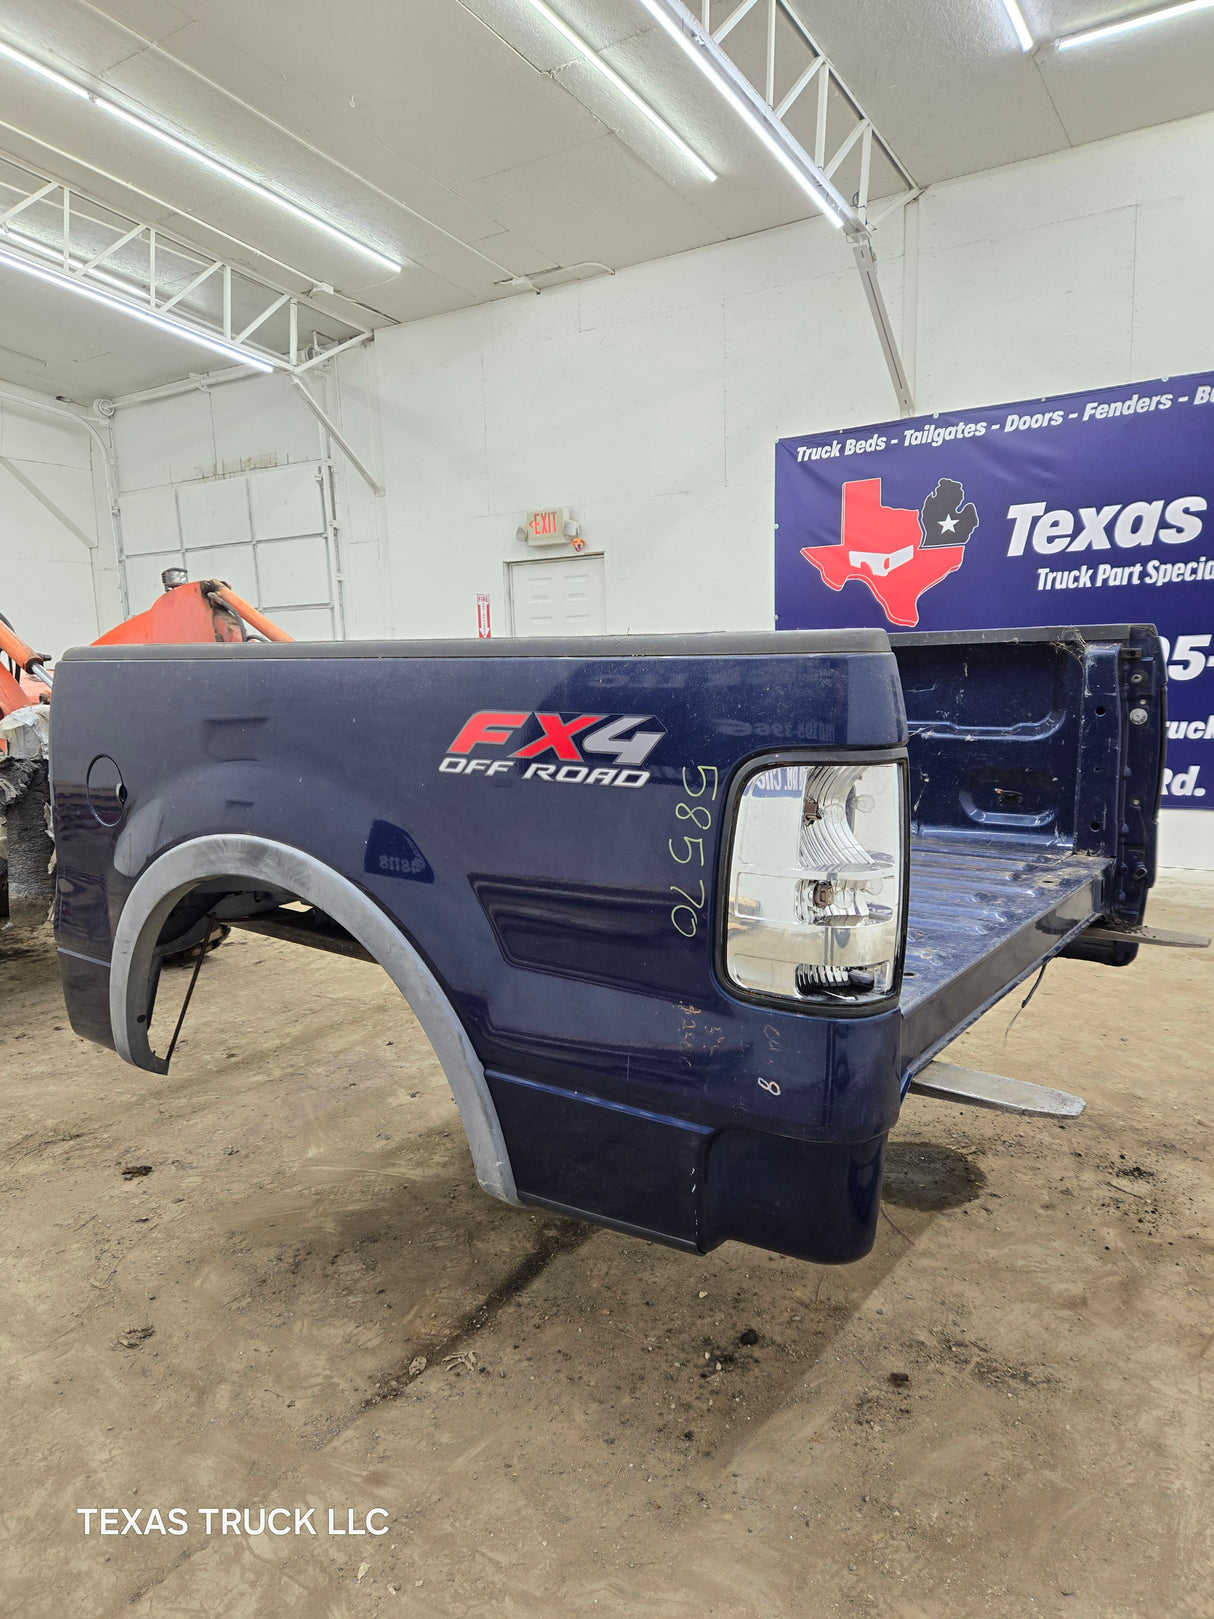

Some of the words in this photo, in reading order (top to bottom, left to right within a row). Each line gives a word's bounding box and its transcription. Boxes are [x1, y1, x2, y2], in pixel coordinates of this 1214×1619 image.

[797, 440, 842, 462] Truck
[844, 433, 887, 455] Beds
[903, 421, 987, 447] Tailgates
[1004, 410, 1064, 432] Doors
[1082, 393, 1173, 421] Fenders
[533, 511, 557, 535] EXIT
[1006, 496, 1208, 557] Texas
[1037, 565, 1094, 591] Truck
[1095, 563, 1143, 587] Part
[446, 709, 668, 766] FX4
[438, 756, 516, 777] OFF
[521, 763, 652, 789] ROAD
